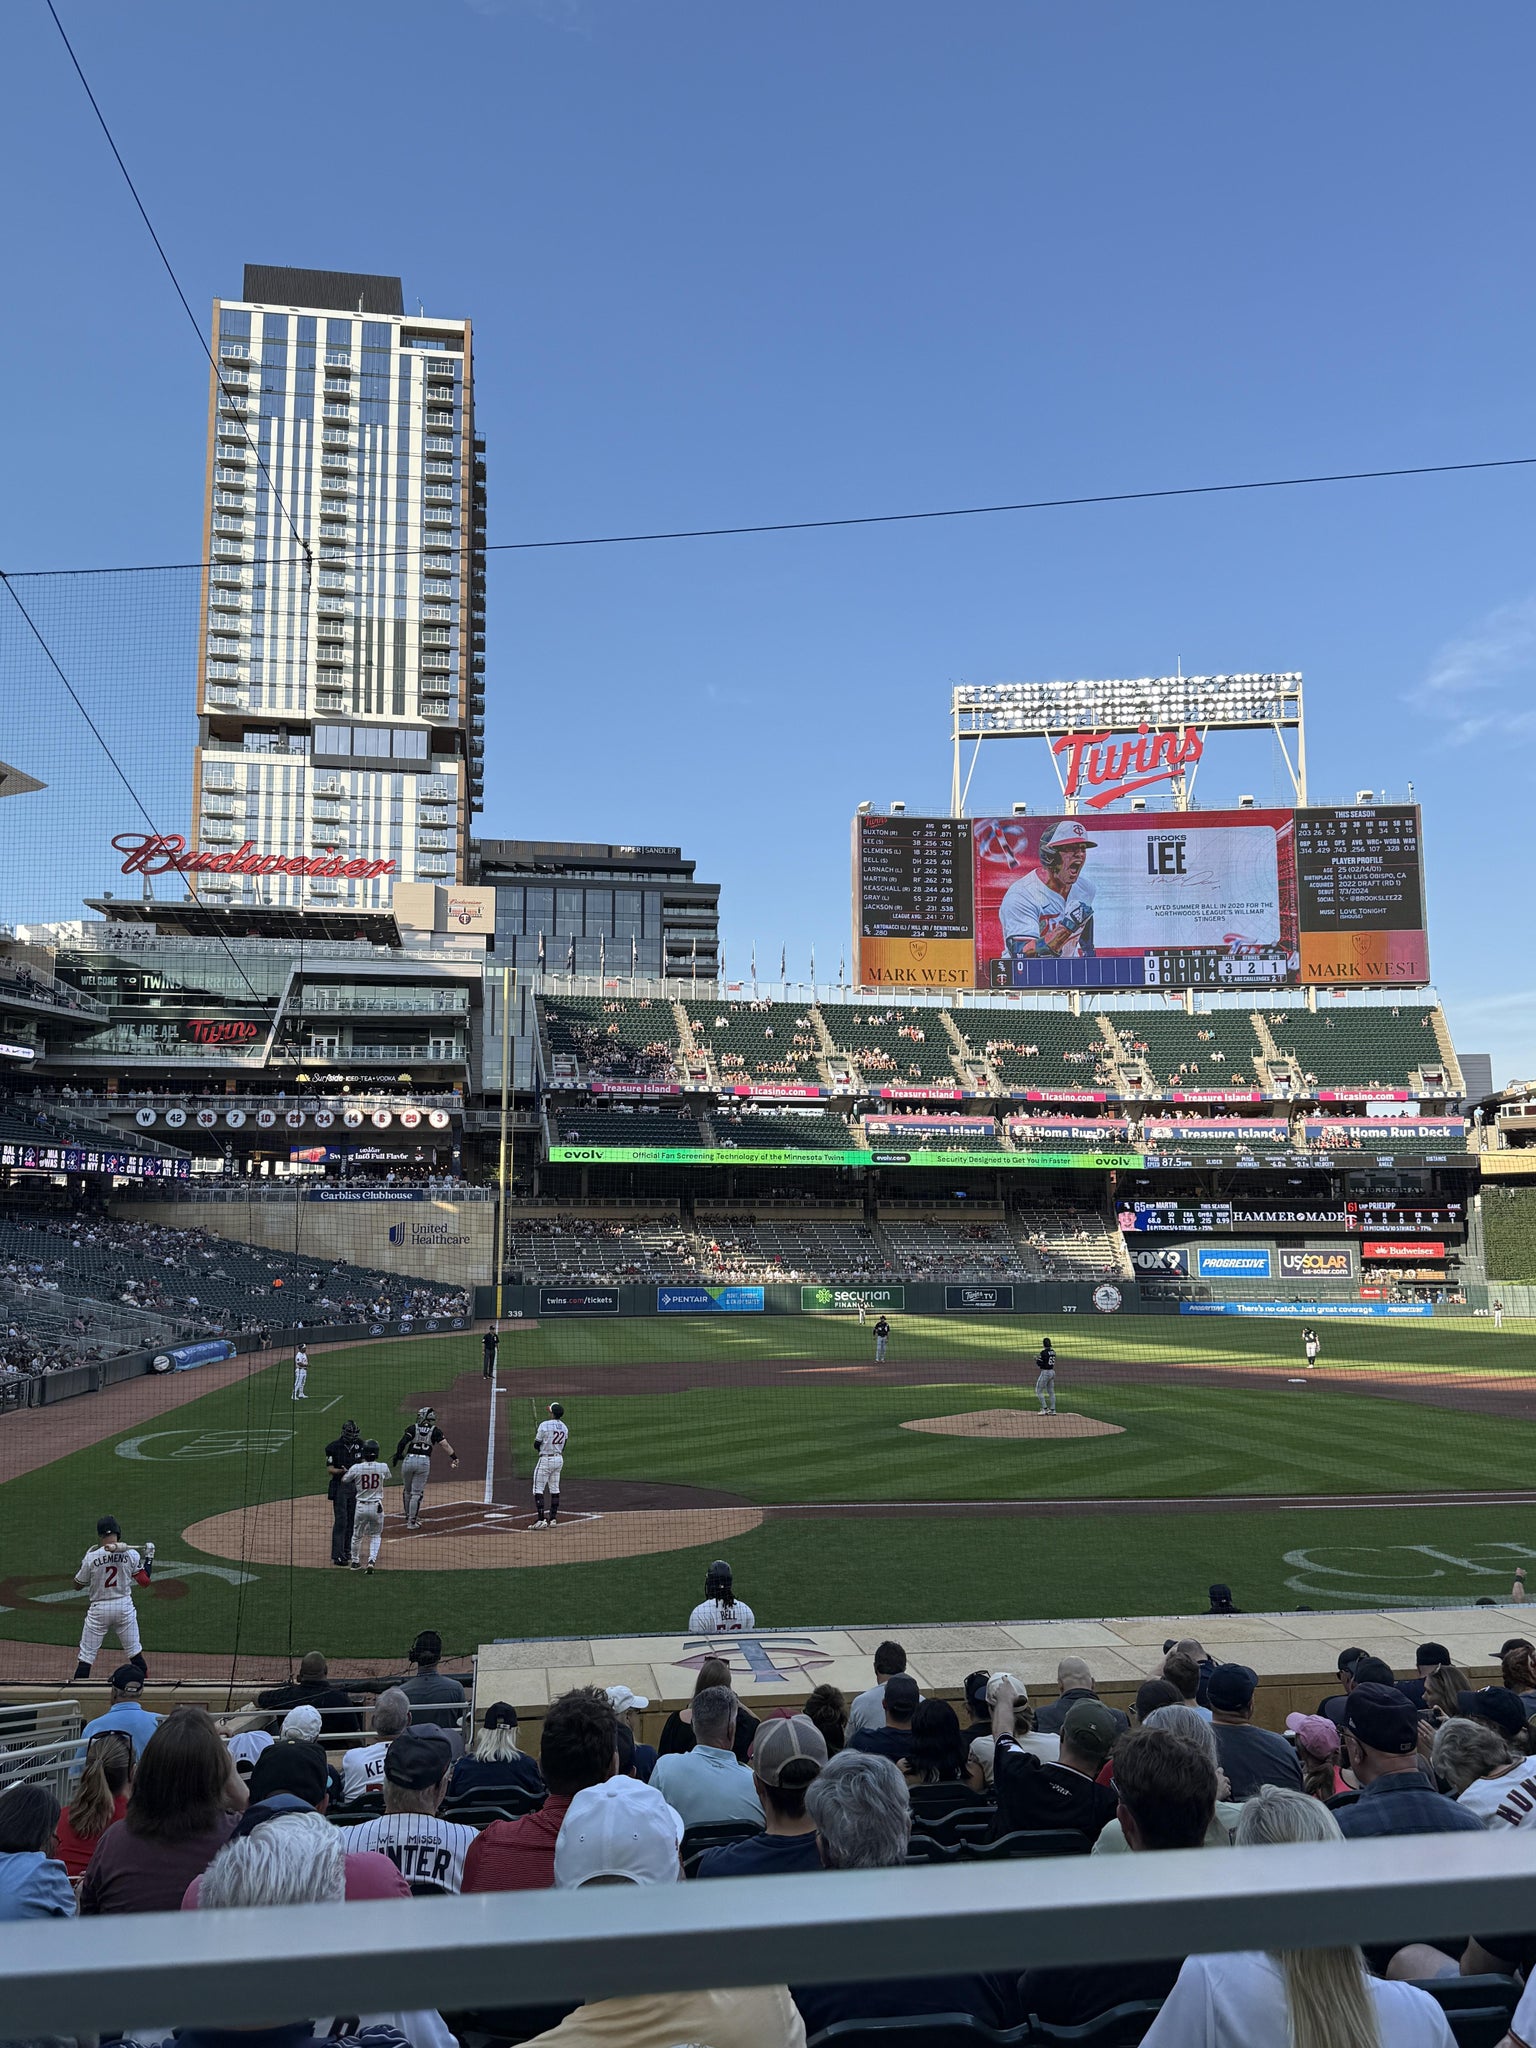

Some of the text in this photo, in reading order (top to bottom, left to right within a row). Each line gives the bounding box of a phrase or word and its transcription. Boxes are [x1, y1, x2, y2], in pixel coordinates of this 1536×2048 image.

[1052, 722, 1203, 809] Twins
[111, 833, 397, 879] Budweiser
[1148, 842, 1186, 874] LEE
[1225, 962, 1276, 973] 3 2 1
[1309, 962, 1418, 976] MARK WEST
[869, 968, 968, 982] MARK WEST
[81, 976, 117, 986] WELCOME
[143, 975, 183, 989] TWINS
[193, 976, 254, 989] TERRITORY
[117, 1024, 135, 1035] WE
[139, 1024, 158, 1037] ARE
[187, 1020, 257, 1043] Twins
[312, 1073, 343, 1082] Surfside
[602, 1084, 671, 1093] Treasure Island
[890, 1089, 954, 1099] Treasure Island
[1183, 1092, 1252, 1102] Treasure Island
[142, 1113, 149, 1122] W
[318, 1114, 330, 1123] 34
[348, 1114, 358, 1123] 14
[405, 1114, 416, 1123] 29
[950, 1125, 985, 1136] Island
[1037, 1128, 1067, 1138] Home
[1180, 1128, 1276, 1138] Treasure Island
[1350, 1127, 1450, 1138] Home Run Deck
[2, 1156, 14, 1165] BOS
[330, 1153, 353, 1161] Swg
[564, 1150, 604, 1159] evolv
[717, 1153, 758, 1161] Technology
[1096, 1157, 1130, 1166] evolv
[320, 1191, 412, 1200] Carbliss Clubhouse
[1134, 1202, 1145, 1212] 65
[1348, 1203, 1357, 1211] 61
[1234, 1212, 1345, 1221] HAMMER MADE
[412, 1224, 447, 1233] United
[411, 1235, 470, 1244] Healthcare
[1202, 1258, 1268, 1268] PROGRESSIVE
[834, 1291, 890, 1300] securian
[1318, 1306, 1340, 1314] great
[552, 1431, 564, 1444] 22
[362, 1474, 379, 1489] BB
[94, 1554, 128, 1567] CLEMENS
[105, 1566, 117, 1588] 2
[720, 1611, 737, 1620] BELL
[408, 1836, 442, 1845] MISSED
[370, 1845, 451, 1881] NTER
